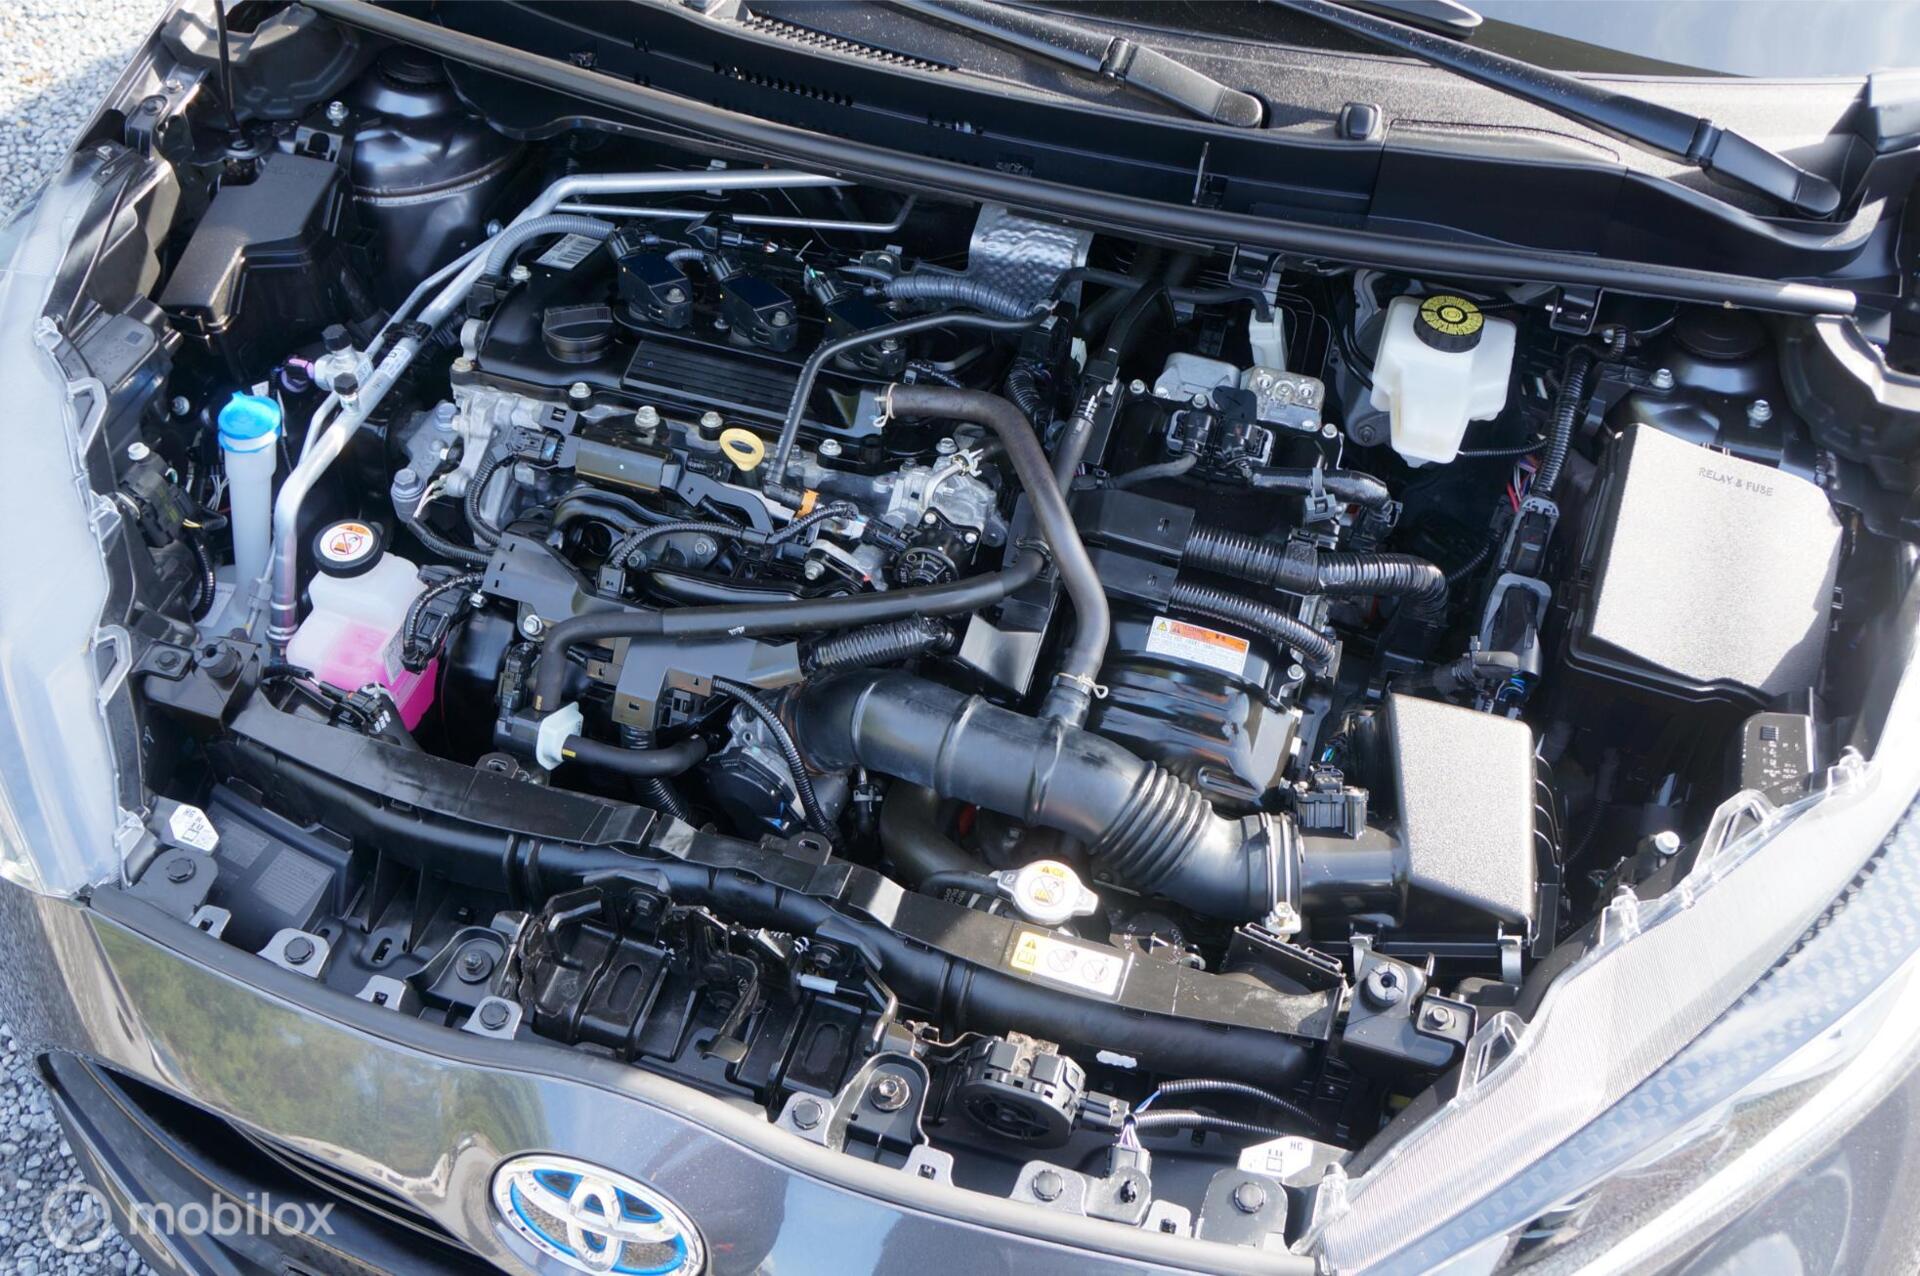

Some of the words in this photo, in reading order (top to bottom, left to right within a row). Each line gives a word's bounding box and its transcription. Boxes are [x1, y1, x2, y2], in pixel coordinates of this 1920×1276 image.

[1698, 466, 1734, 485] RELAY
[1735, 478, 1743, 488] &
[1745, 480, 1774, 497] FUSE
